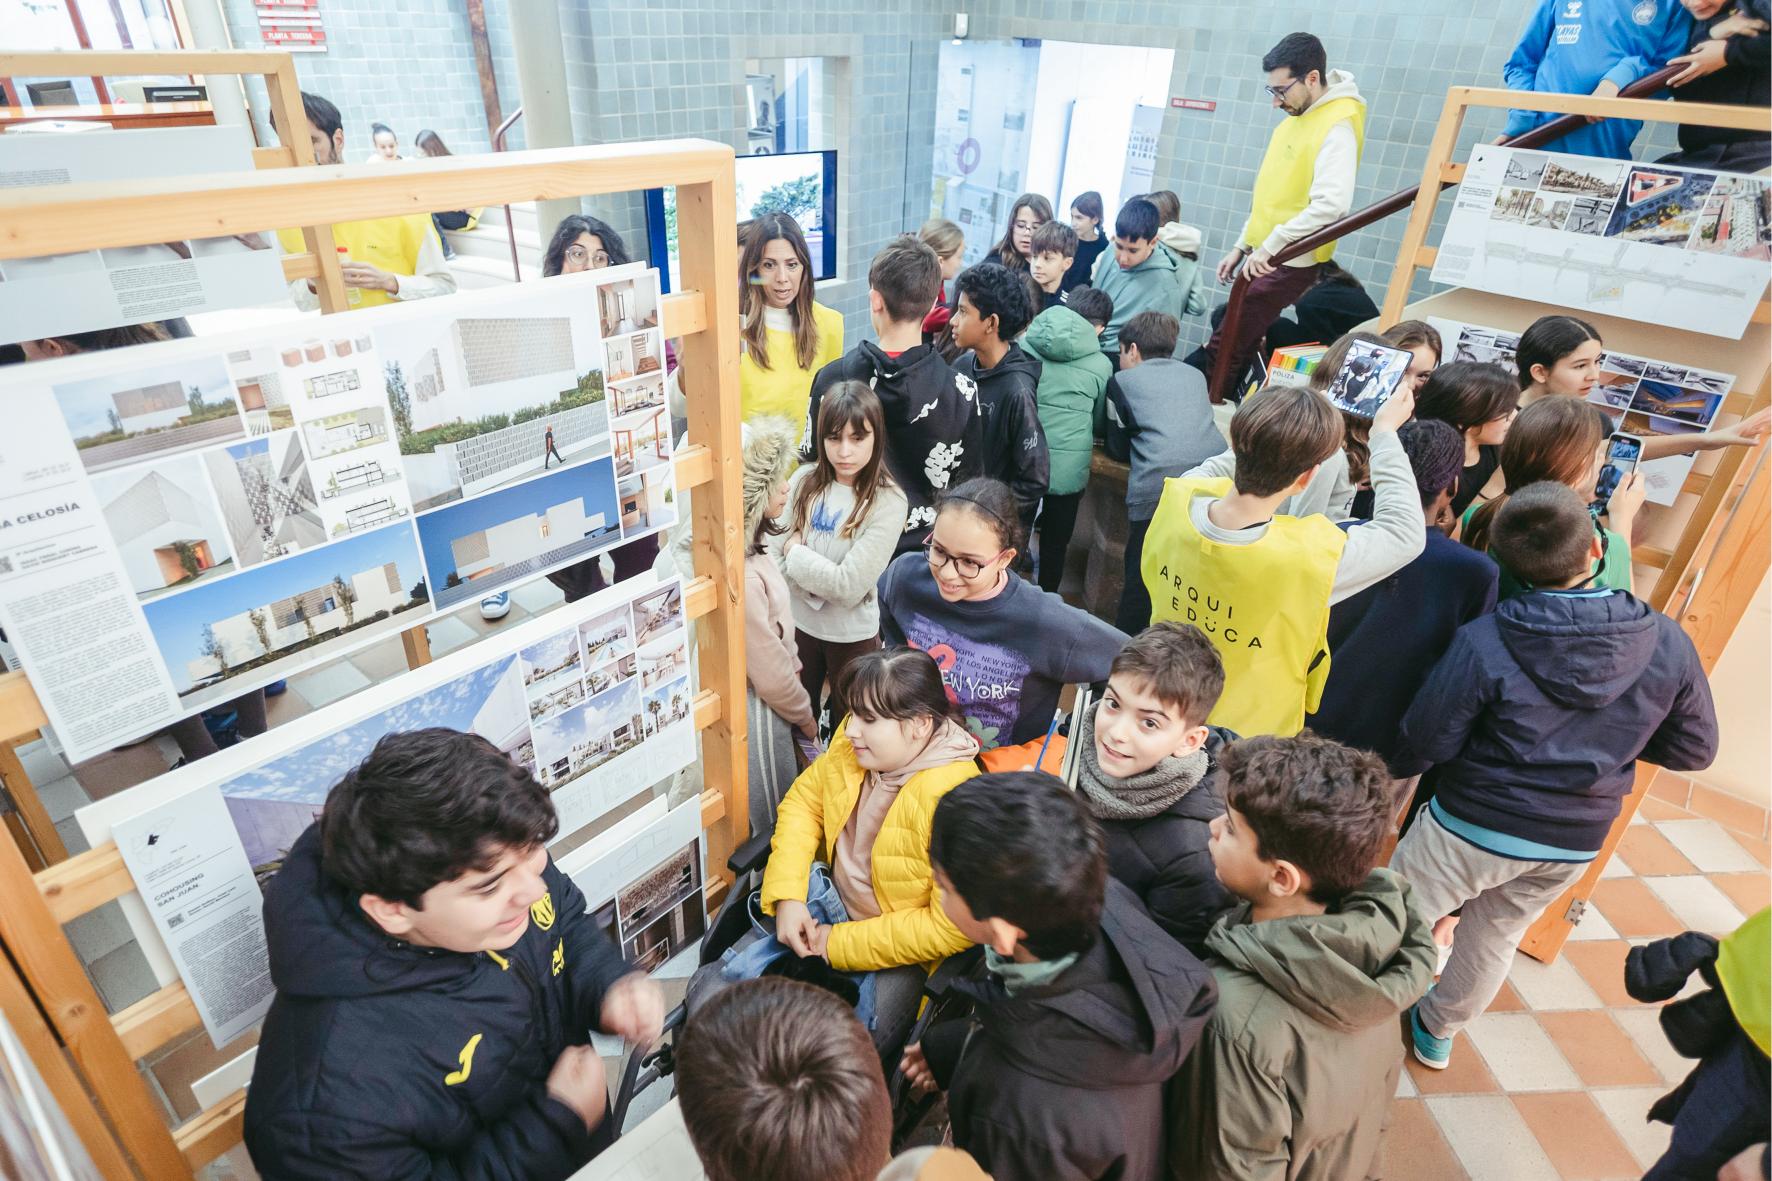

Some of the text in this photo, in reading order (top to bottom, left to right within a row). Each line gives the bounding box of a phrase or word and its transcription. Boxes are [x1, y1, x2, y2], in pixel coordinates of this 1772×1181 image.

[16, 502, 81, 524] CELOSÍA
[1160, 565, 1232, 620] ARQUI
[966, 677, 1020, 700] YORK
[154, 872, 204, 901] COHOUSING
[157, 896, 175, 908] SAN
[177, 882, 199, 898] JUAN
